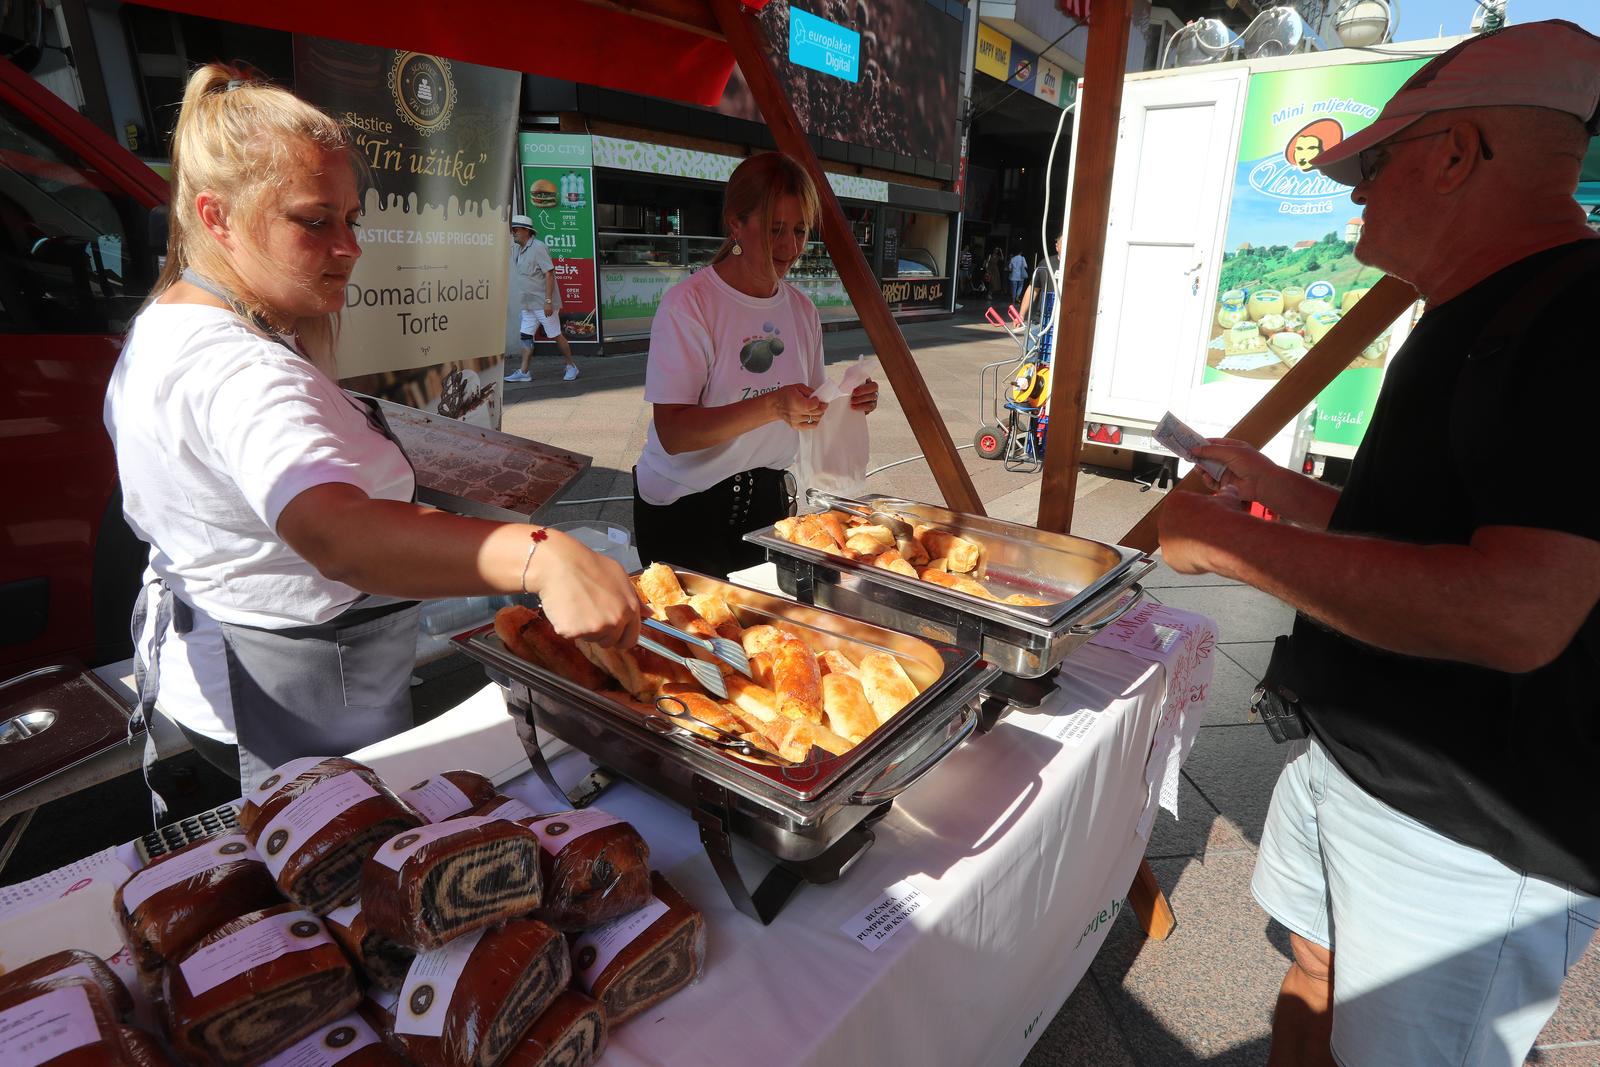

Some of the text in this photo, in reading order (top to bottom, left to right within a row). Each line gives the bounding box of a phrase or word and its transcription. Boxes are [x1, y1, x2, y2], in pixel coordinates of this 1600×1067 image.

[808, 30, 851, 54] europlakat
[980, 38, 994, 59] HAPPY
[826, 51, 851, 73] Digital
[1045, 68, 1056, 88] dm
[346, 111, 393, 134] Slastice
[1272, 98, 1378, 125] Mini mljekara
[524, 143, 556, 153] FOOD
[1280, 201, 1334, 214] Desinić
[357, 228, 495, 247] ASTICE ZA SVE PRIGODE
[544, 234, 577, 247] Grill
[558, 254, 565, 263] &
[345, 278, 490, 309] Domaći kolači
[396, 312, 449, 336] Torte
[1331, 410, 1364, 430] užitak
[856, 890, 921, 941] PUMPKIN STRUDEL
[865, 896, 897, 922] BUČNICA
[891, 901, 921, 926] KN/KOM
